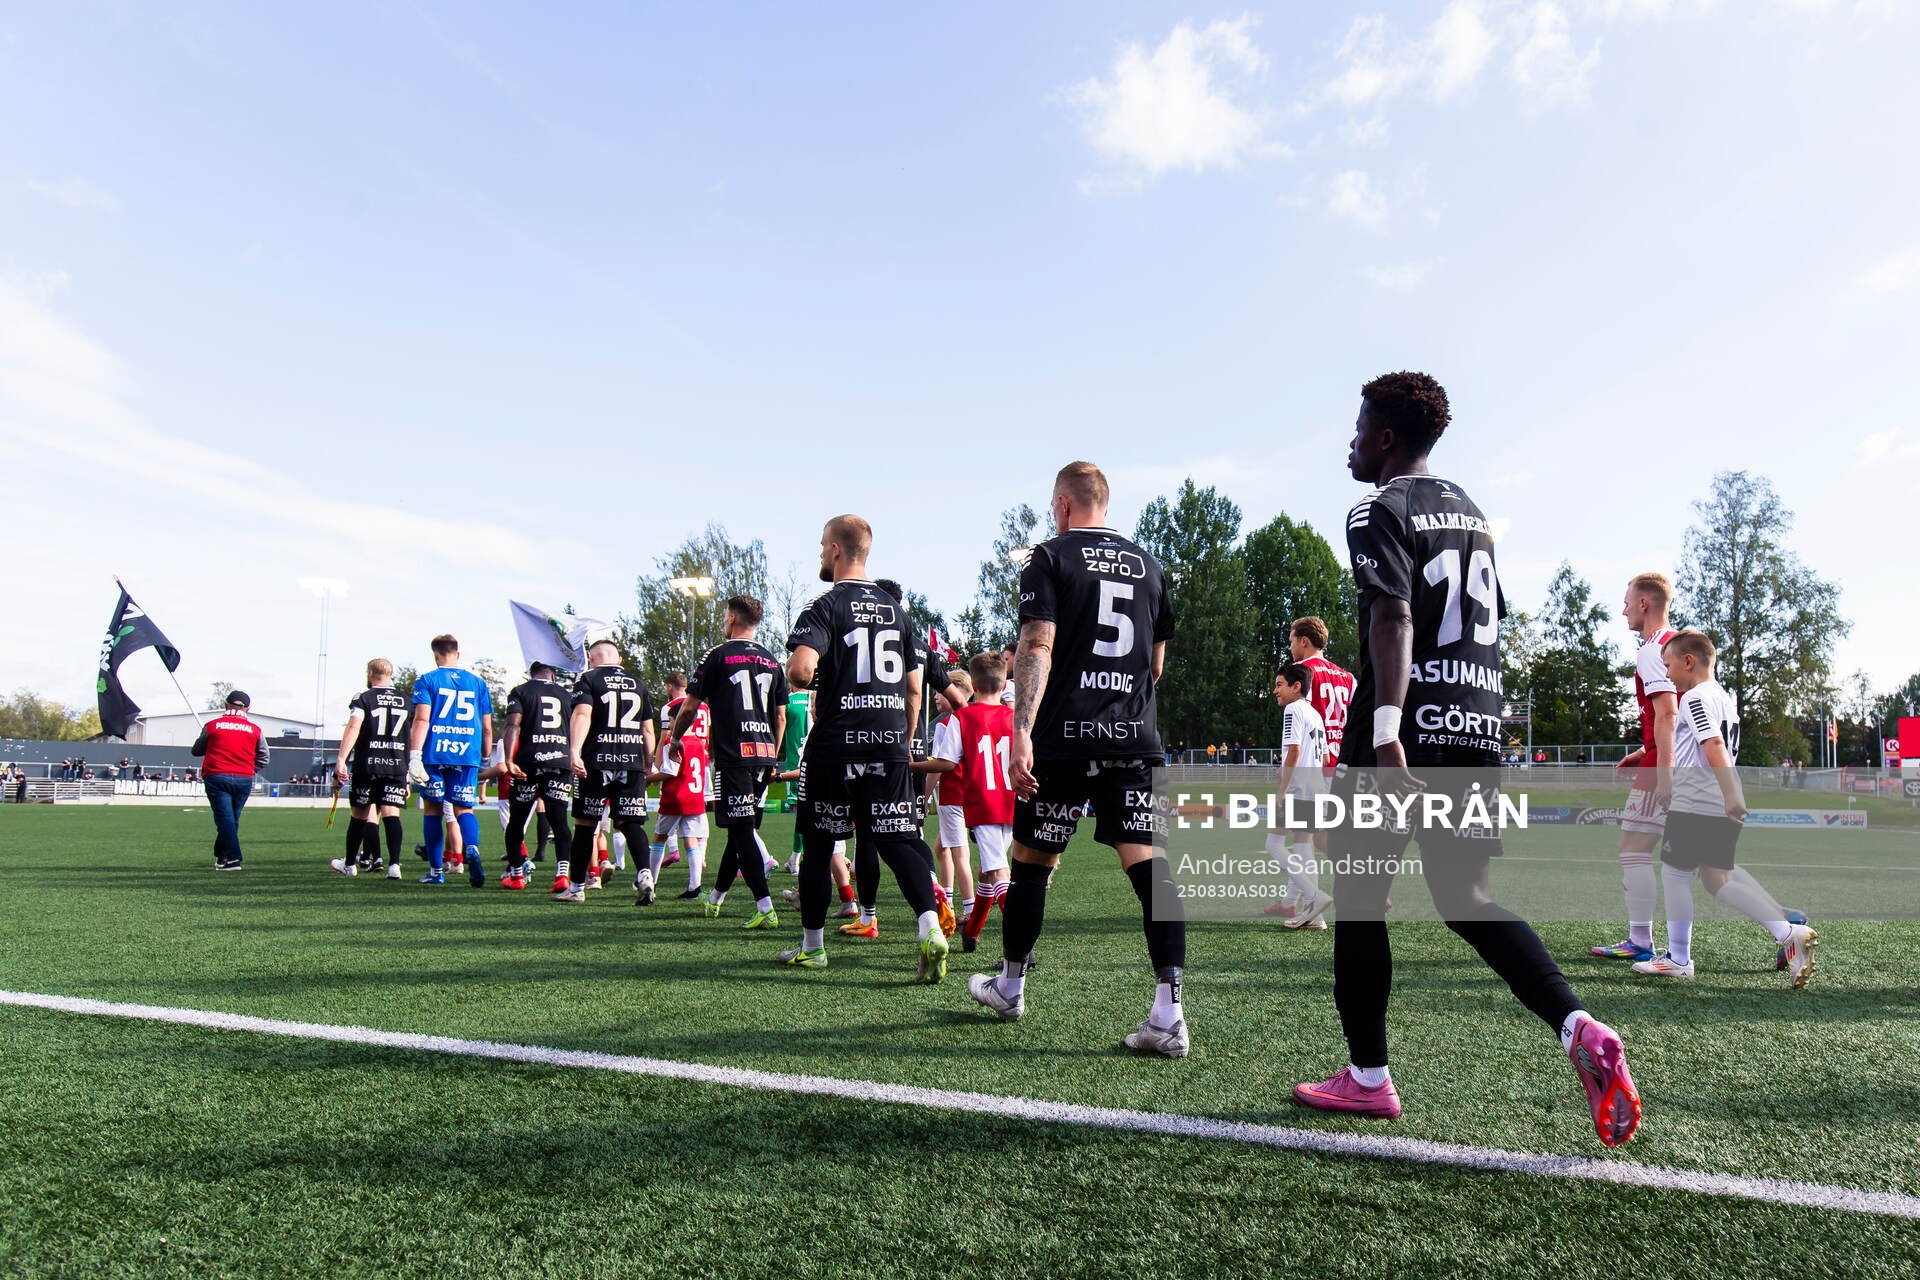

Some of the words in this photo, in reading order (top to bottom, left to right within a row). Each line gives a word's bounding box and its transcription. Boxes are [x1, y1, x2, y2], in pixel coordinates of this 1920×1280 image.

[1423, 549, 1499, 648] 19
[1092, 580, 1134, 657] 5
[843, 627, 903, 684] 16
[729, 669, 773, 713] 11
[1080, 671, 1134, 693] MODIG
[438, 688, 476, 721] 75
[541, 696, 561, 729] 3
[600, 691, 641, 730] 12
[1320, 683, 1349, 728] 26
[216, 722, 253, 733] PERSONAL
[371, 707, 408, 737] 17
[436, 738, 470, 756] itsy
[978, 734, 1013, 791] 11
[688, 757, 702, 793] 3
[871, 801, 913, 816] EXACT
[1036, 802, 1082, 821] EXAC
[1125, 790, 1169, 812] EXAC
